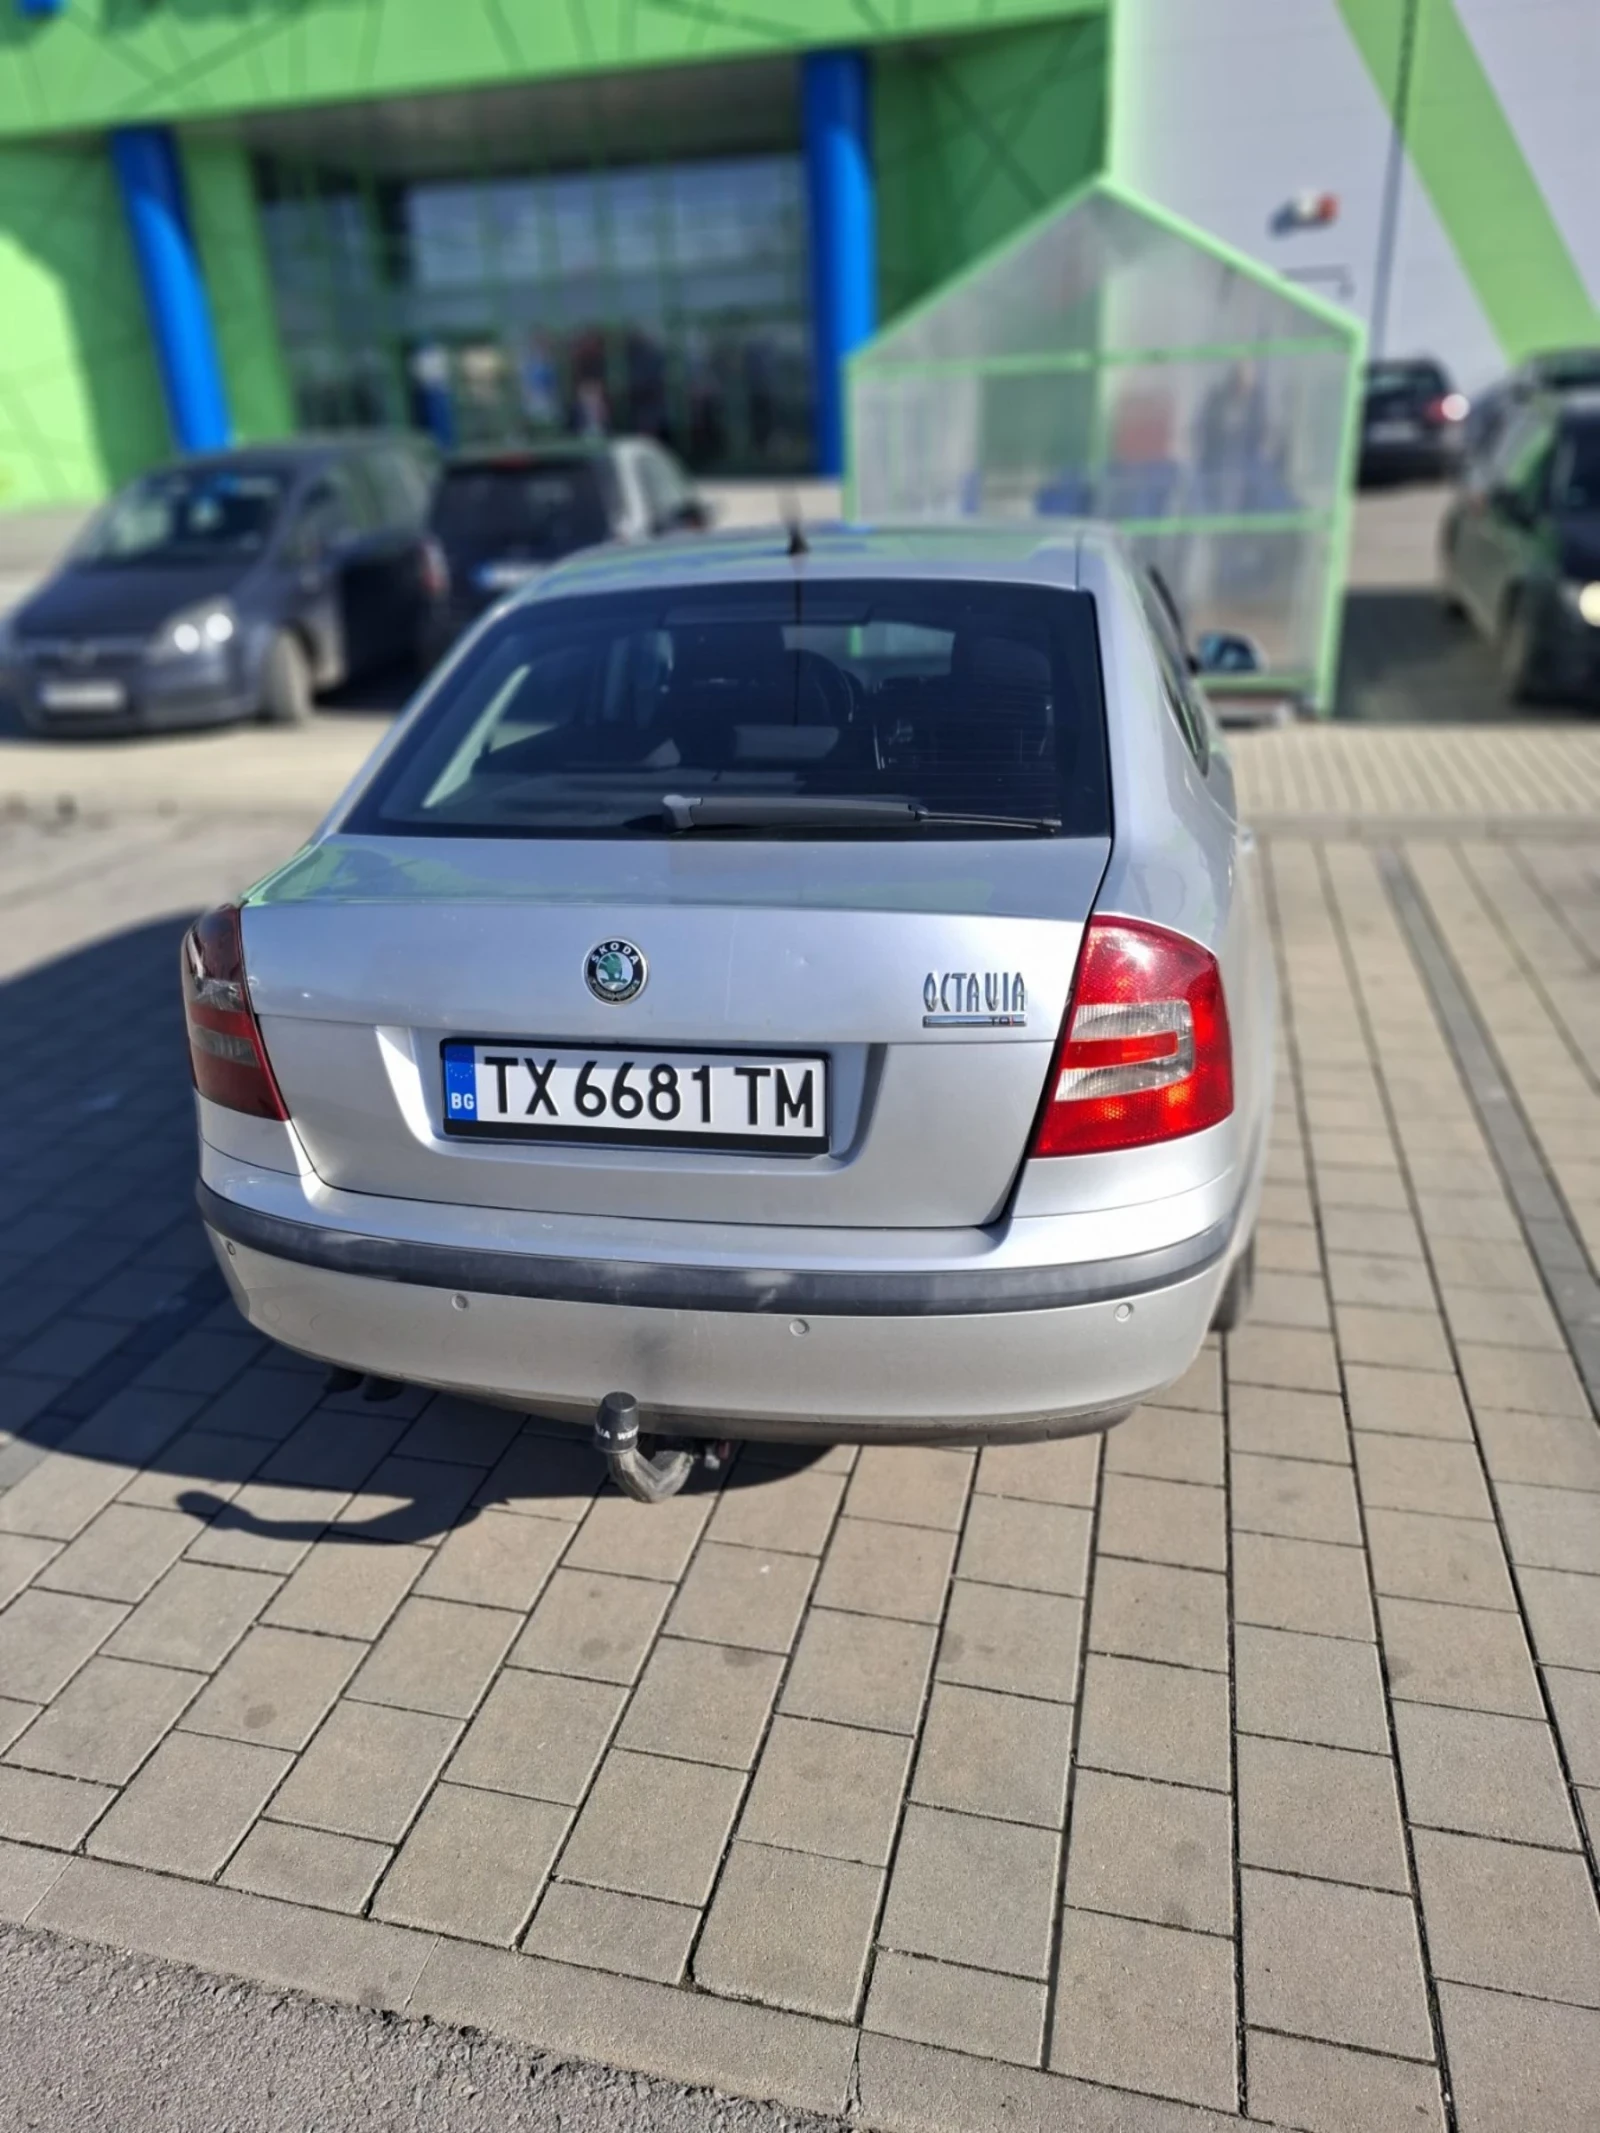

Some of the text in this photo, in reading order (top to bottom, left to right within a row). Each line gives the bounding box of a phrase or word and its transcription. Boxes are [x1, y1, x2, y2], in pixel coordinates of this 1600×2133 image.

[923, 971, 1025, 1012] OCTAVIA
[451, 1092, 475, 1110] BG
[484, 1056, 813, 1128] TX 6681 TM
